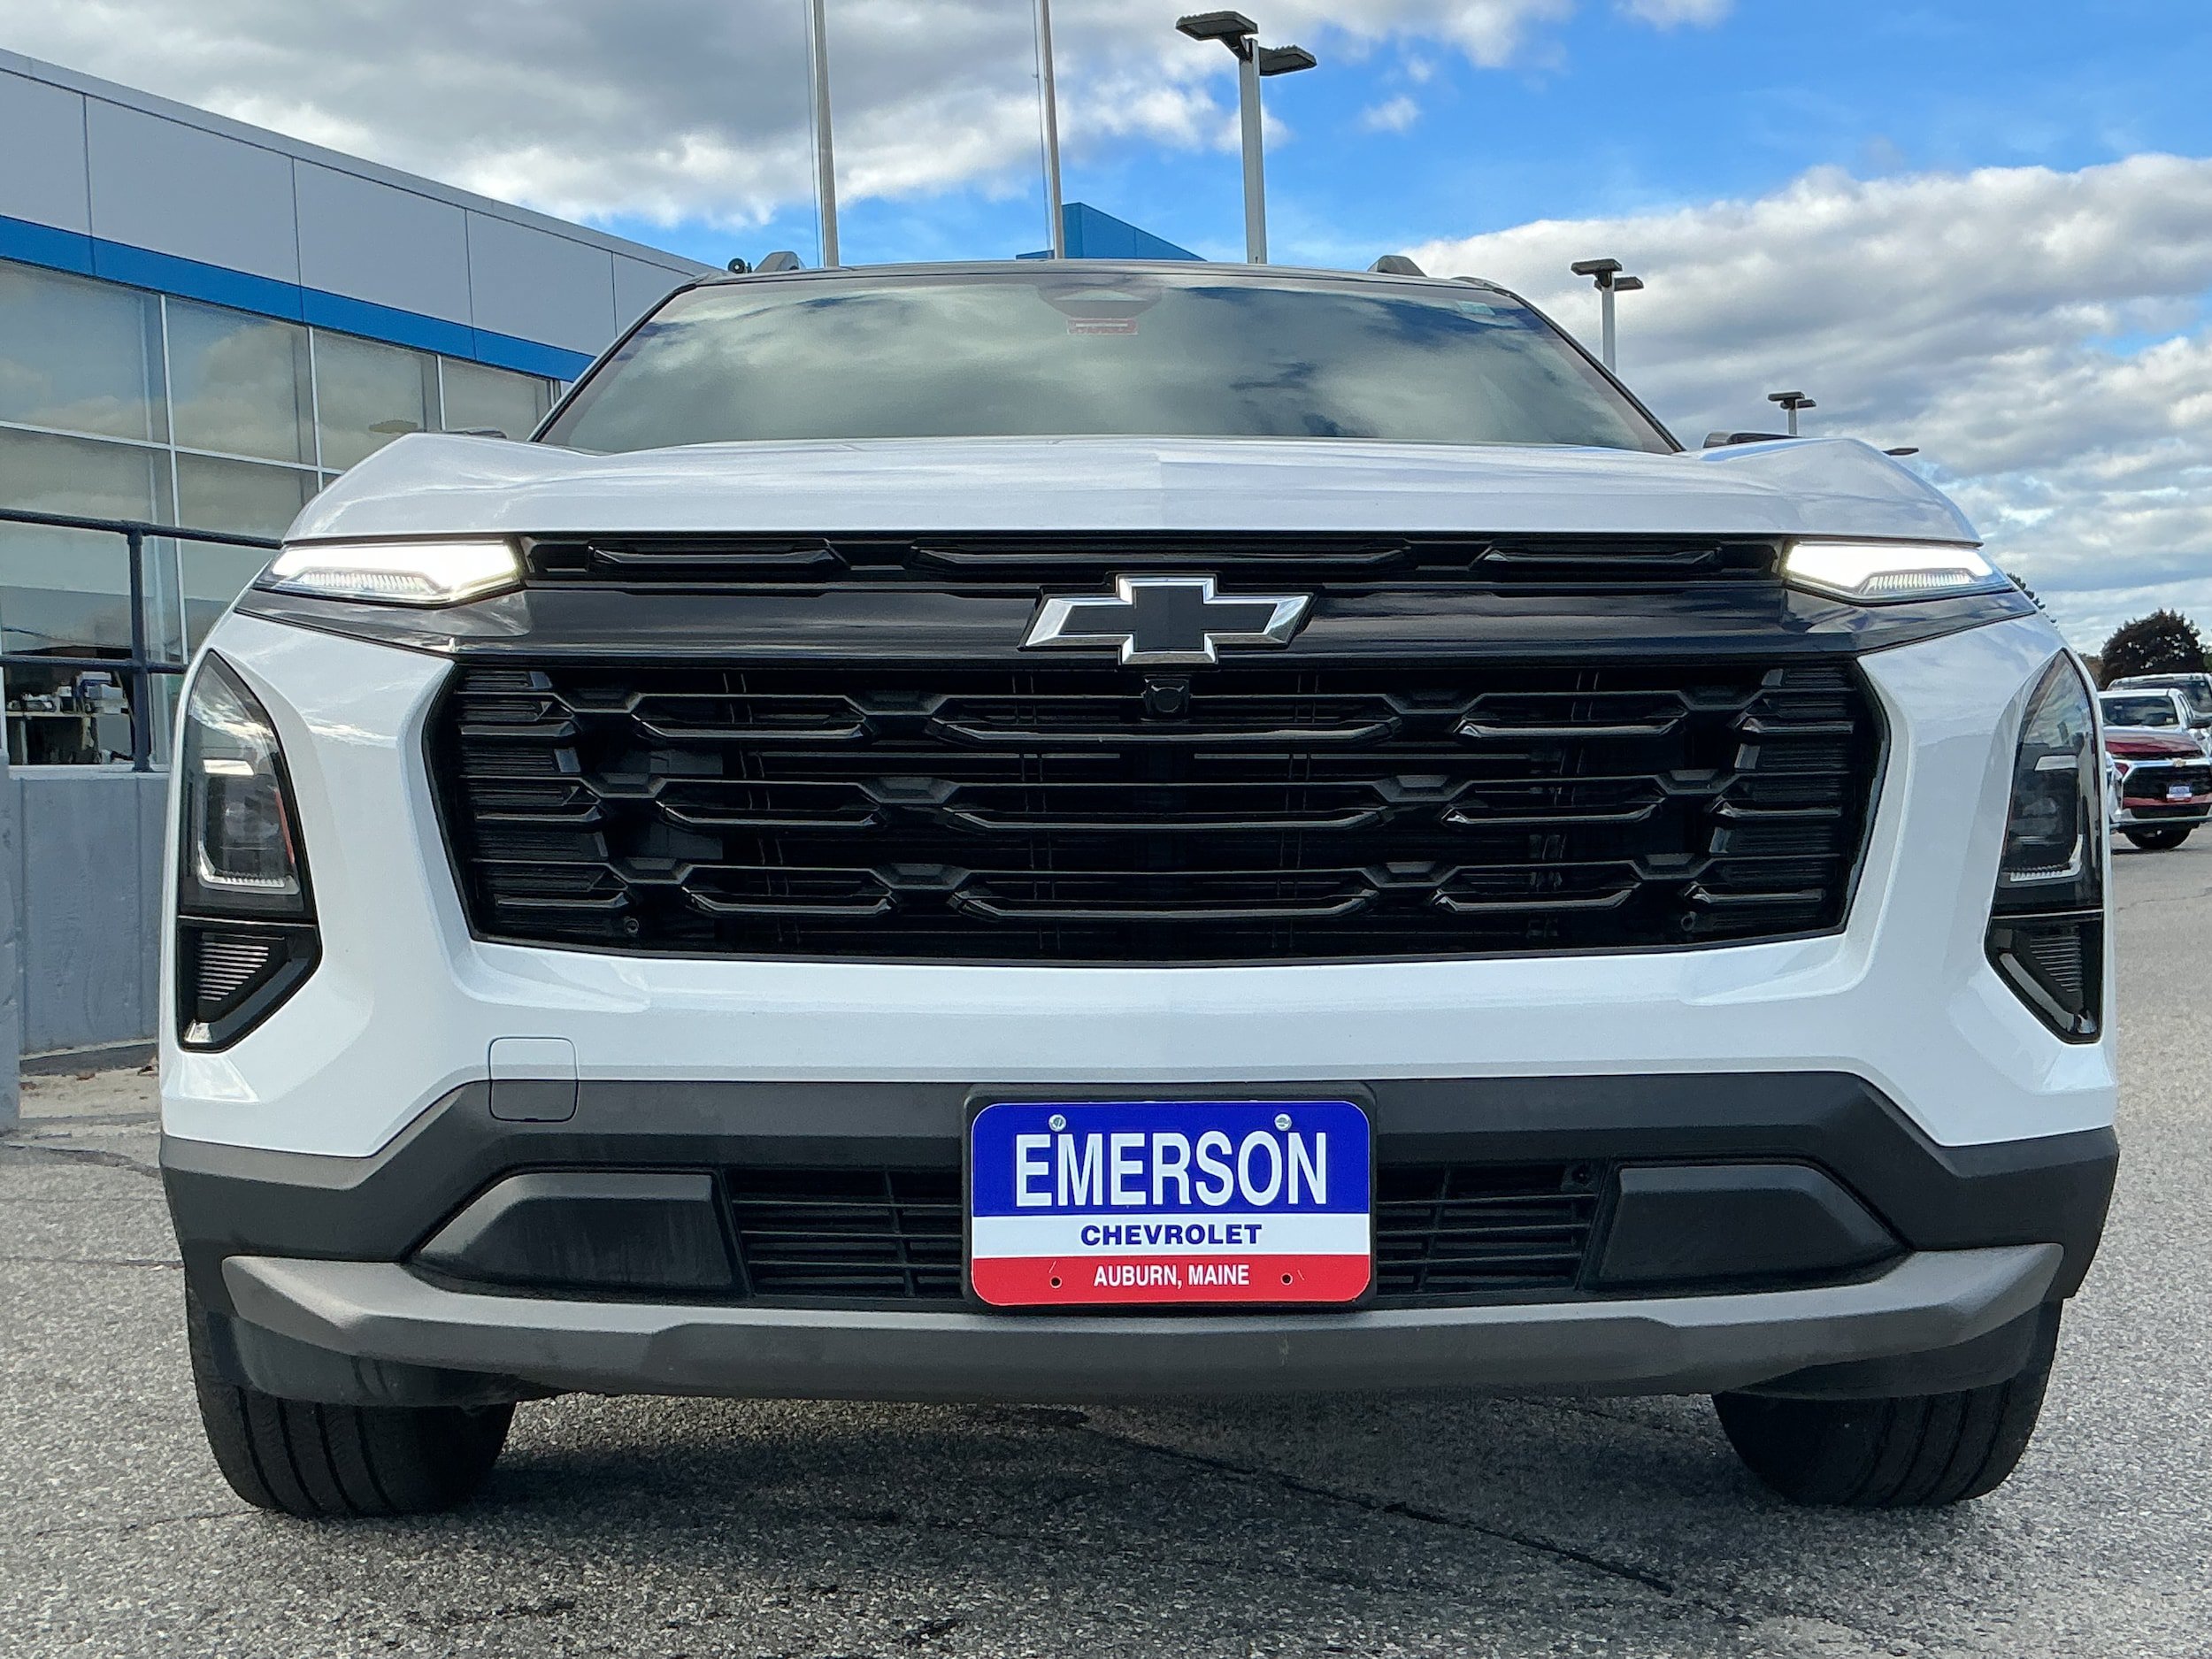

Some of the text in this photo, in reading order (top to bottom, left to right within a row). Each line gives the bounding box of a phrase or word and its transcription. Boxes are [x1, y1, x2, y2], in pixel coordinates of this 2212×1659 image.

[1016, 1131, 1326, 1207] EMERSON
[1080, 1223, 1262, 1246] CHEVROLET
[1093, 1263, 1249, 1290] AUBURN, MAINE
